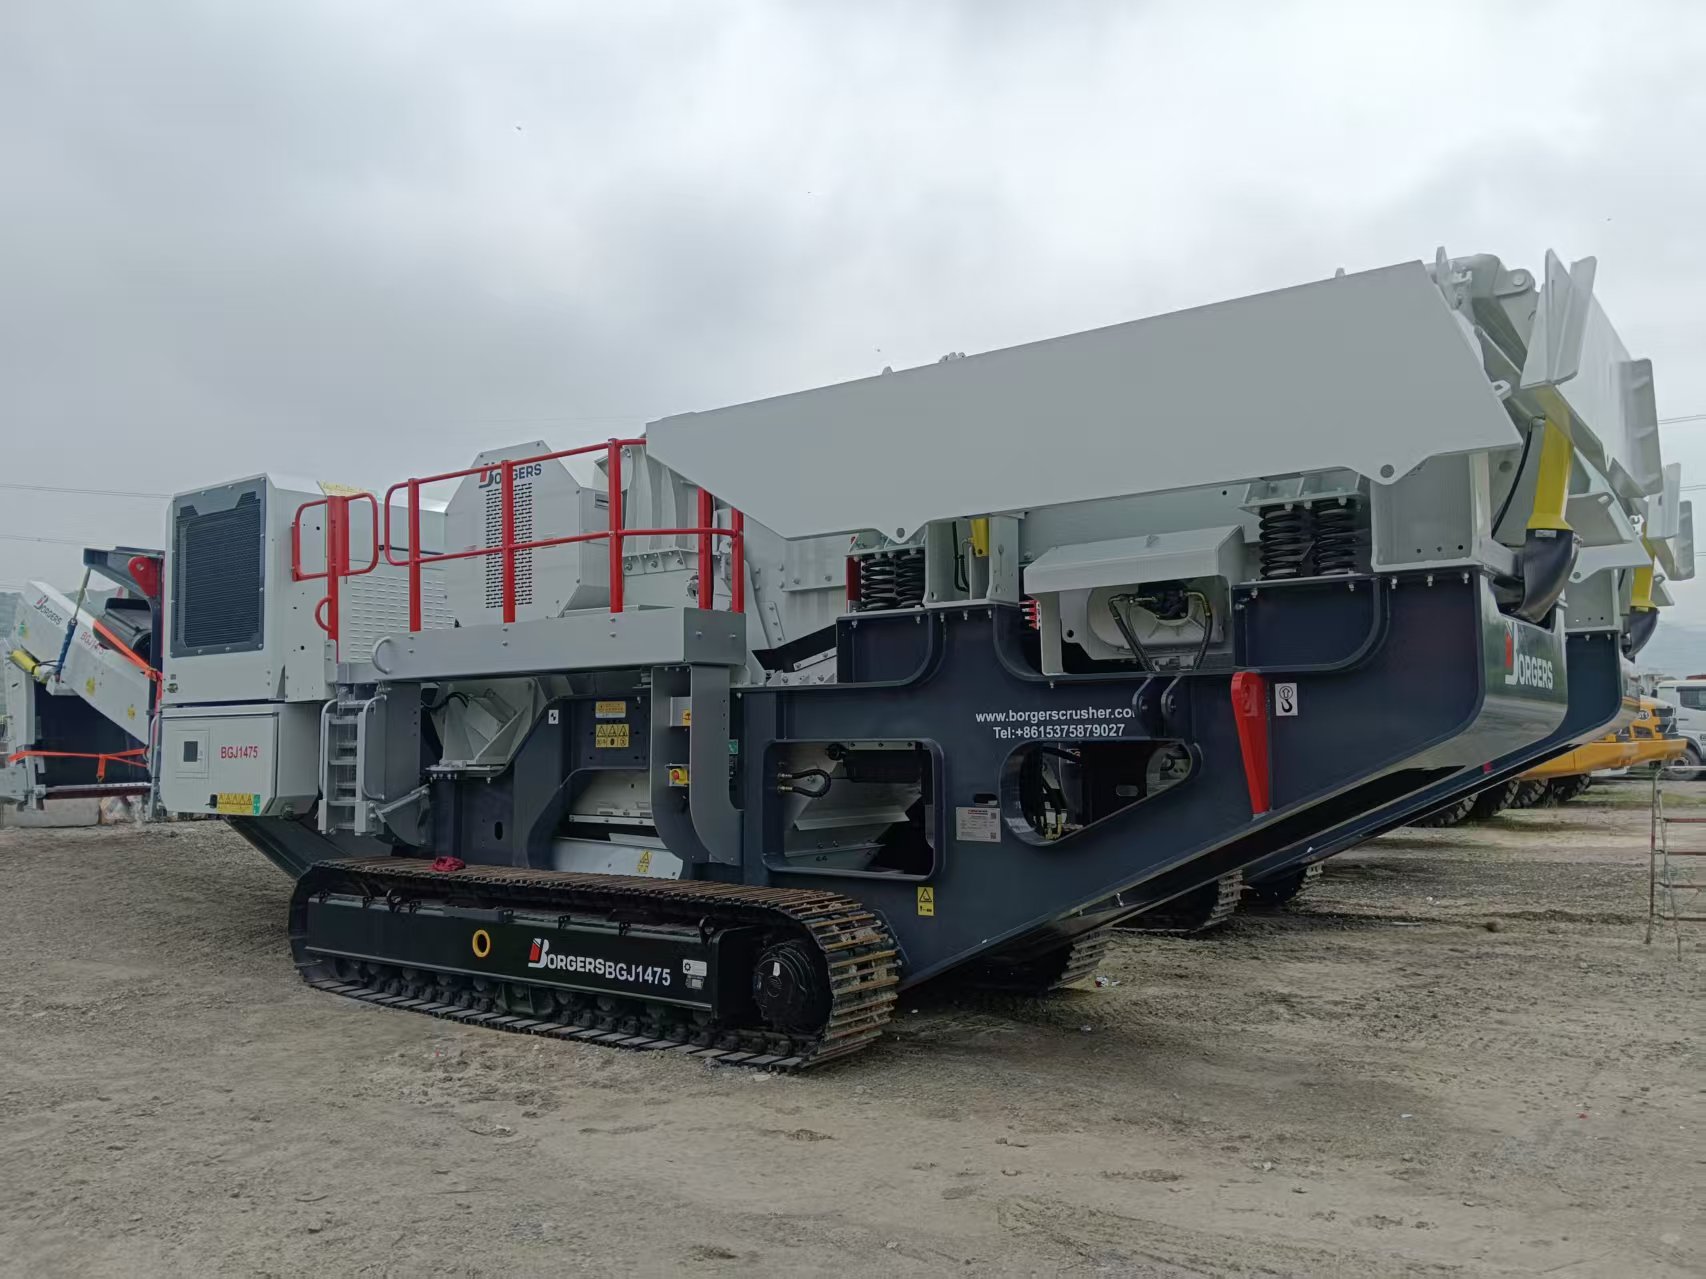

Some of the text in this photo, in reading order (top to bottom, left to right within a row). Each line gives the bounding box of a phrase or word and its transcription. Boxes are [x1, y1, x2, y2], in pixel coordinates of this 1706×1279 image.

[478, 462, 542, 489] BOGERS
[976, 706, 1135, 724] www.borgerscrusher.co
[993, 723, 1126, 739] Tel:+8615375879027
[220, 745, 259, 759] BGJ1475
